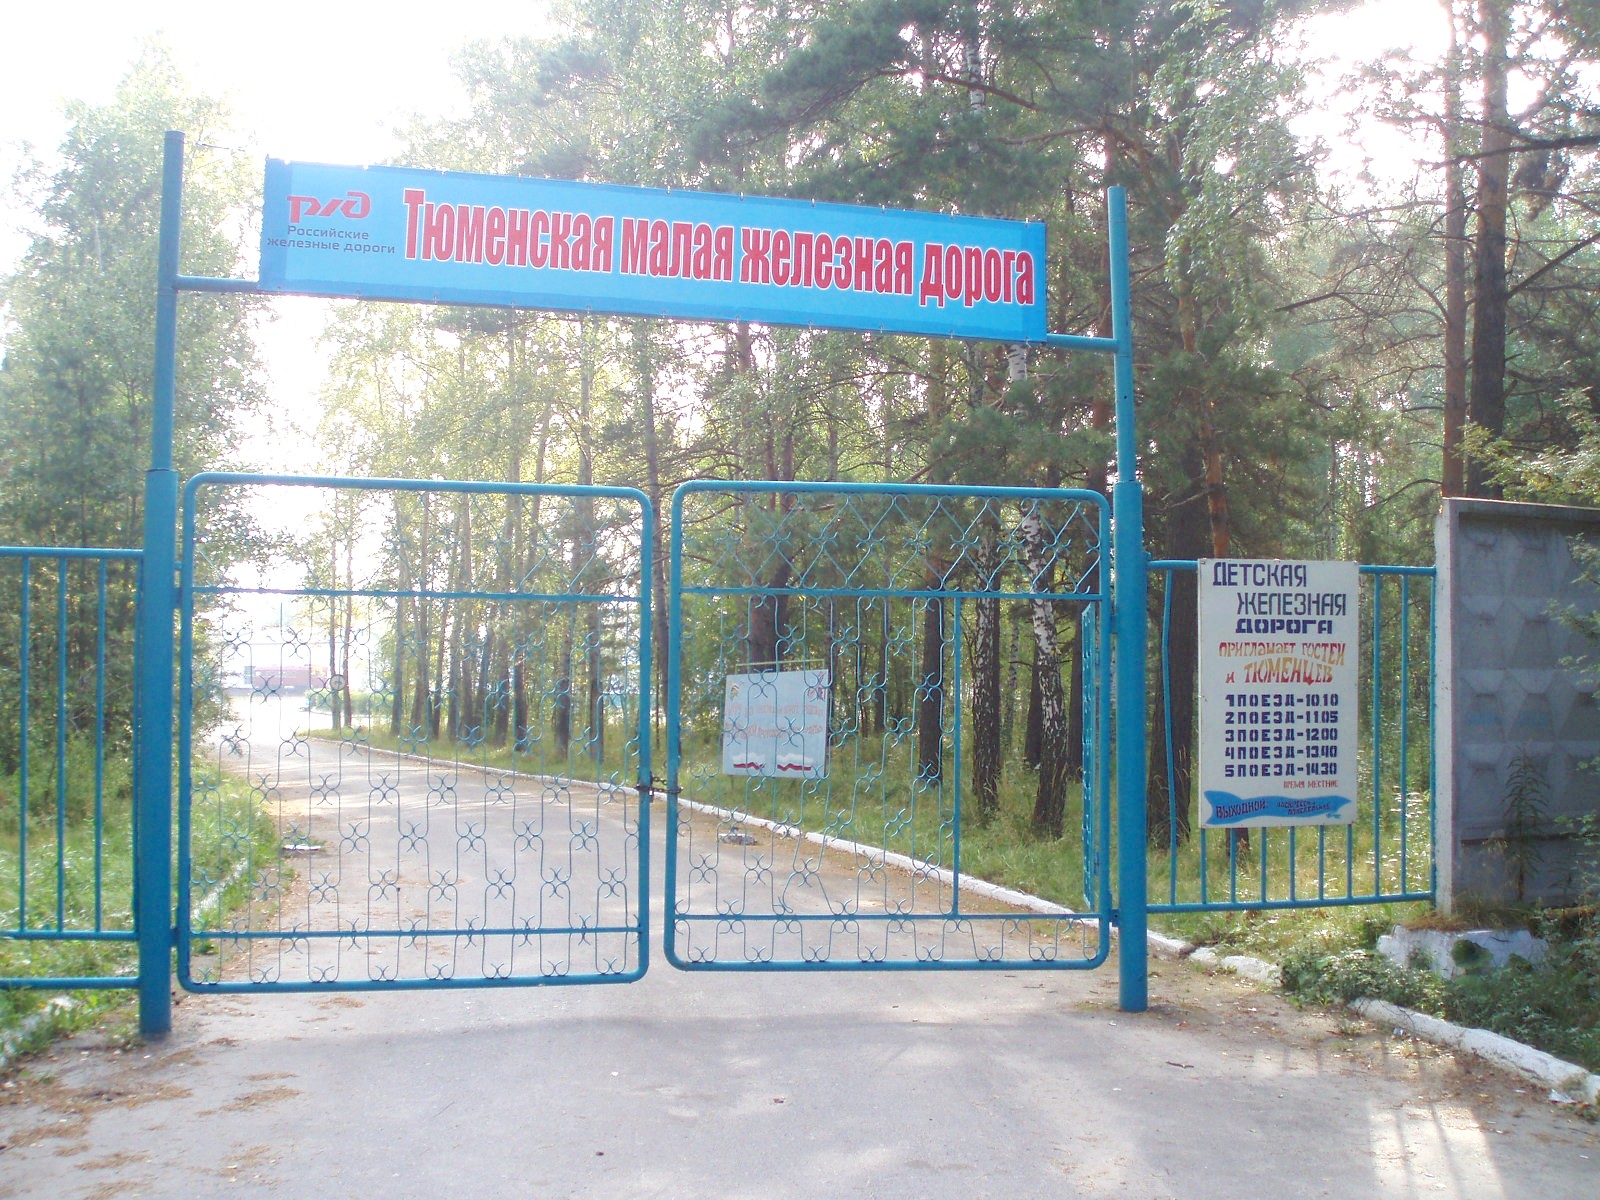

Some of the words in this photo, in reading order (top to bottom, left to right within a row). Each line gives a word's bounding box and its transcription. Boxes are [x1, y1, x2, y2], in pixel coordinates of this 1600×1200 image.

[287, 225, 370, 240] Российские
[267, 237, 340, 250] железные
[343, 243, 396, 254] дороги
[403, 188, 614, 273] Тюменская
[620, 217, 734, 282] малая
[739, 226, 914, 296] железная
[919, 242, 1035, 308] дорога
[1213, 561, 1307, 587] ДЕТСКАЯ
[1236, 592, 1347, 616] ЖЕЛЕЗНАЯ
[1235, 618, 1333, 634] ДОРОГА
[1243, 656, 1334, 686] ТЮМЕНЦЕВ
